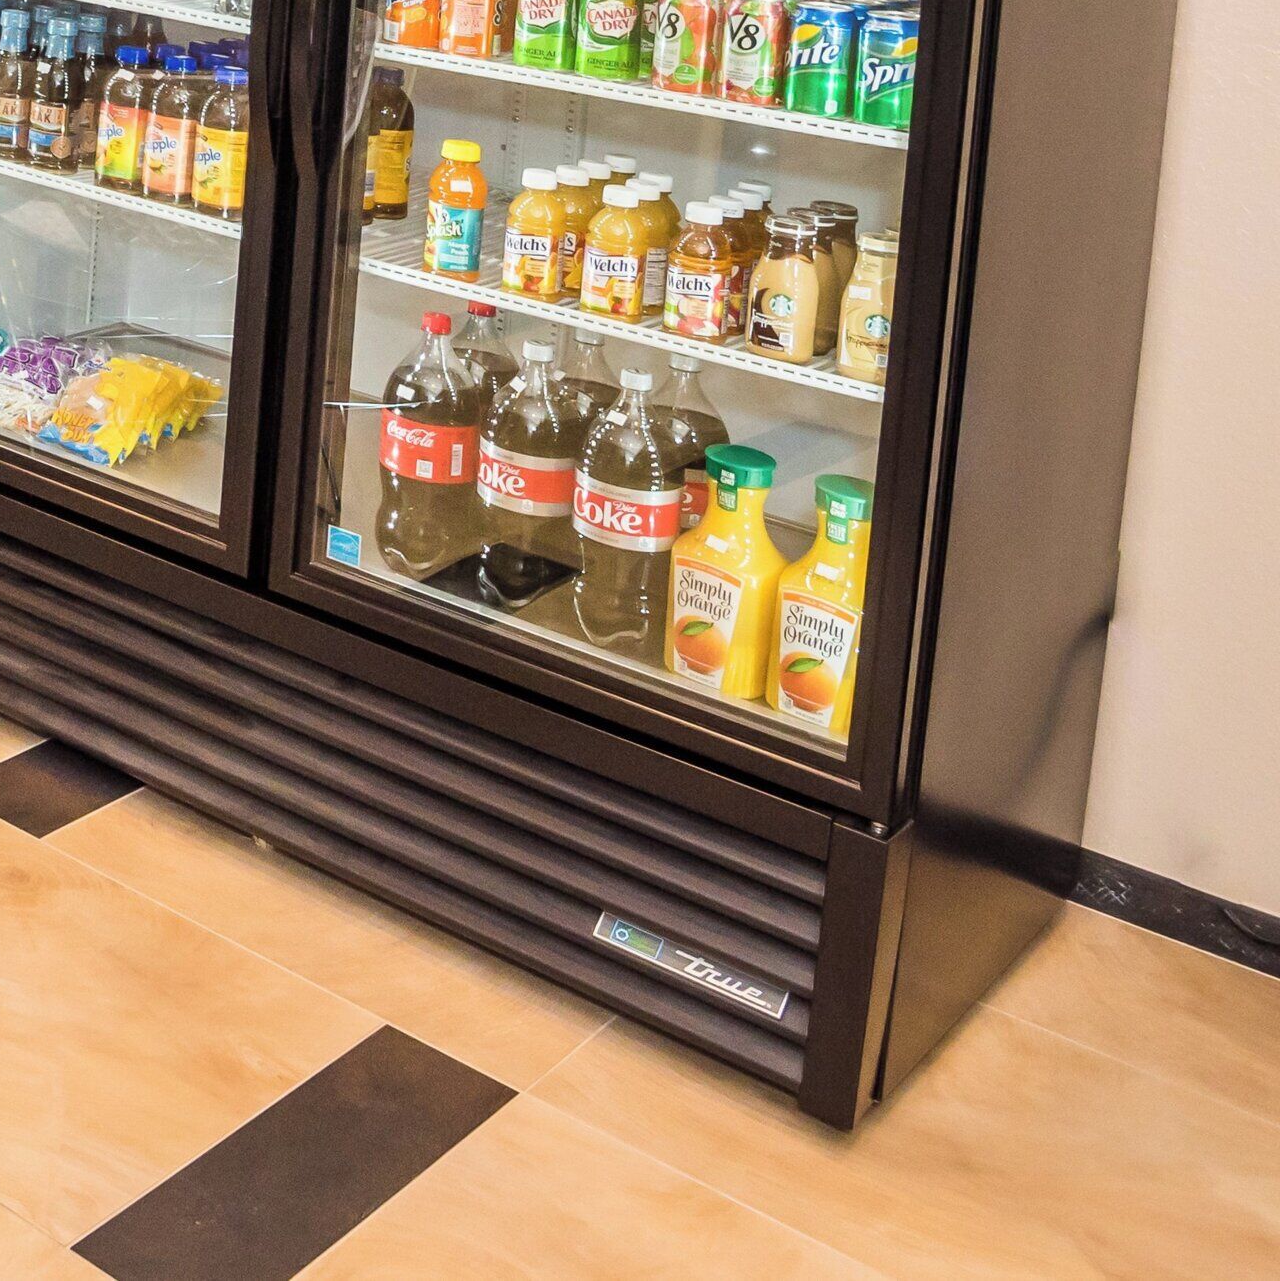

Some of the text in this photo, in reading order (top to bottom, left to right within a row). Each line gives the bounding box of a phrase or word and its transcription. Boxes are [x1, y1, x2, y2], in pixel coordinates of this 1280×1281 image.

[529, 7, 558, 21] DRY
[587, 7, 639, 24] CANADA
[602, 19, 630, 31] DRY
[728, 13, 760, 51] V8
[506, 236, 548, 252] Welch's
[589, 256, 636, 273] Welch's
[666, 271, 712, 292] Welch's
[386, 419, 437, 449] Coca-Cola
[573, 485, 643, 534] Coke
[612, 499, 638, 514] Diet
[679, 568, 732, 607] Simply
[677, 589, 734, 622] Orange
[786, 603, 845, 644] Simply
[783, 625, 845, 659] Orange
[675, 949, 772, 1009] True
